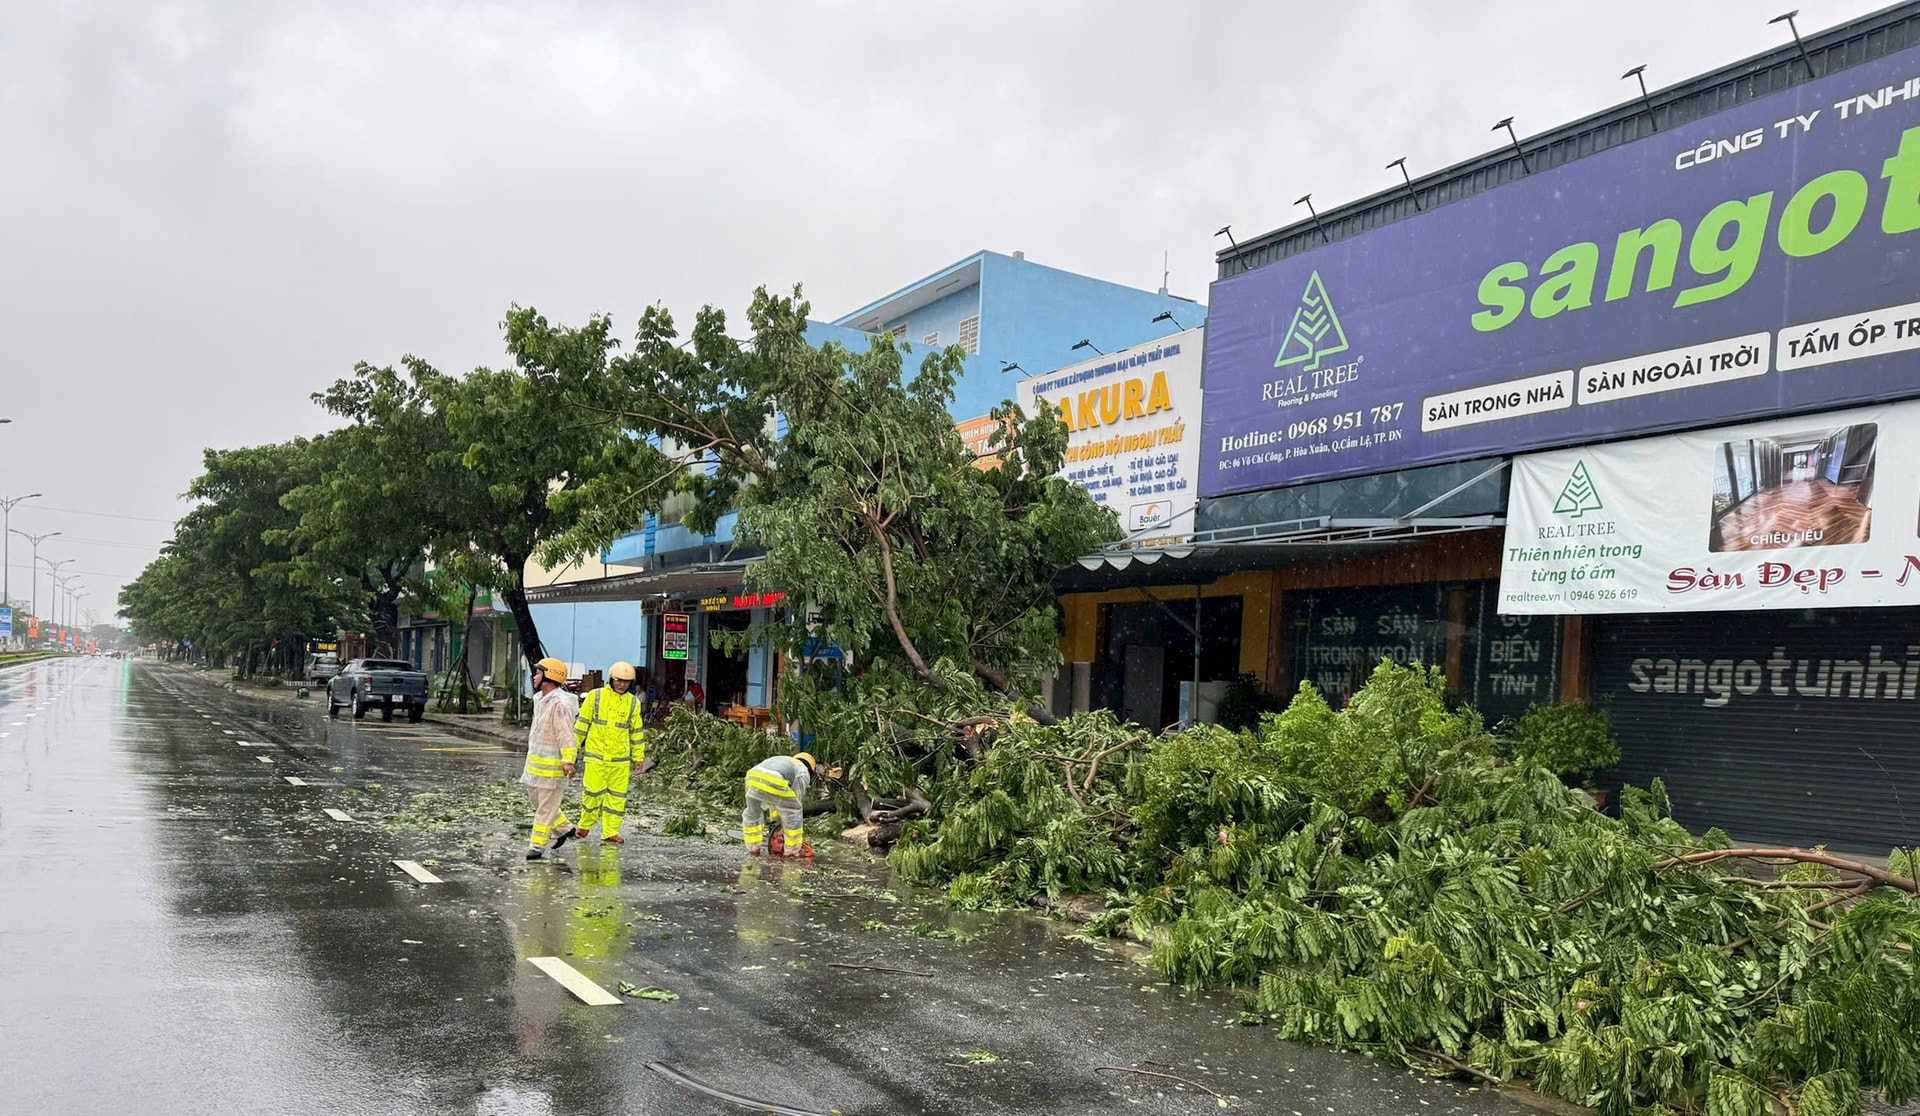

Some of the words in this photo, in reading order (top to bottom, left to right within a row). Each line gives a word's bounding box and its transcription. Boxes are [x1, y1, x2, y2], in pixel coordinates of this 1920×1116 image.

[1675, 127, 1764, 170] CÔNG
[1774, 110, 1821, 139] TY
[1788, 327, 1840, 358] TẤM
[1847, 317, 1887, 348] ỐP
[1586, 370, 1626, 395] SÀN
[1632, 354, 1702, 386] NGOÀI
[1709, 344, 1760, 371] TRỜI
[1261, 374, 1308, 401] REAL
[1277, 395, 1303, 408] Flooring
[1304, 394, 1310, 403] &
[1310, 389, 1338, 401] Paneling
[1428, 402, 1460, 422] SÀN
[1464, 391, 1521, 417] TRONG
[1526, 379, 1565, 405] NHÀ
[1052, 371, 1173, 434] AKURA
[1220, 429, 1283, 453] Hotline:
[1287, 417, 1329, 440] 0968
[1332, 410, 1363, 433] 951
[1370, 402, 1405, 424] 787
[1538, 525, 1576, 540] REAL
[1577, 521, 1616, 537] TREE
[1750, 531, 1791, 545] CHIÊU
[1508, 547, 1550, 562] Thiên
[1552, 545, 1596, 561] nhiên
[1599, 543, 1643, 560] trong
[1531, 567, 1567, 585] từng
[1571, 563, 1590, 581] tổ
[1590, 563, 1615, 579] ấm
[1665, 566, 1745, 593] Sàn
[1757, 561, 1846, 593] Đẹp
[1506, 591, 1561, 602] realtree.vn
[1570, 590, 1595, 601] 0946
[1598, 589, 1617, 600] 926
[1619, 588, 1638, 600] 619
[1321, 607, 1356, 636] SÀN
